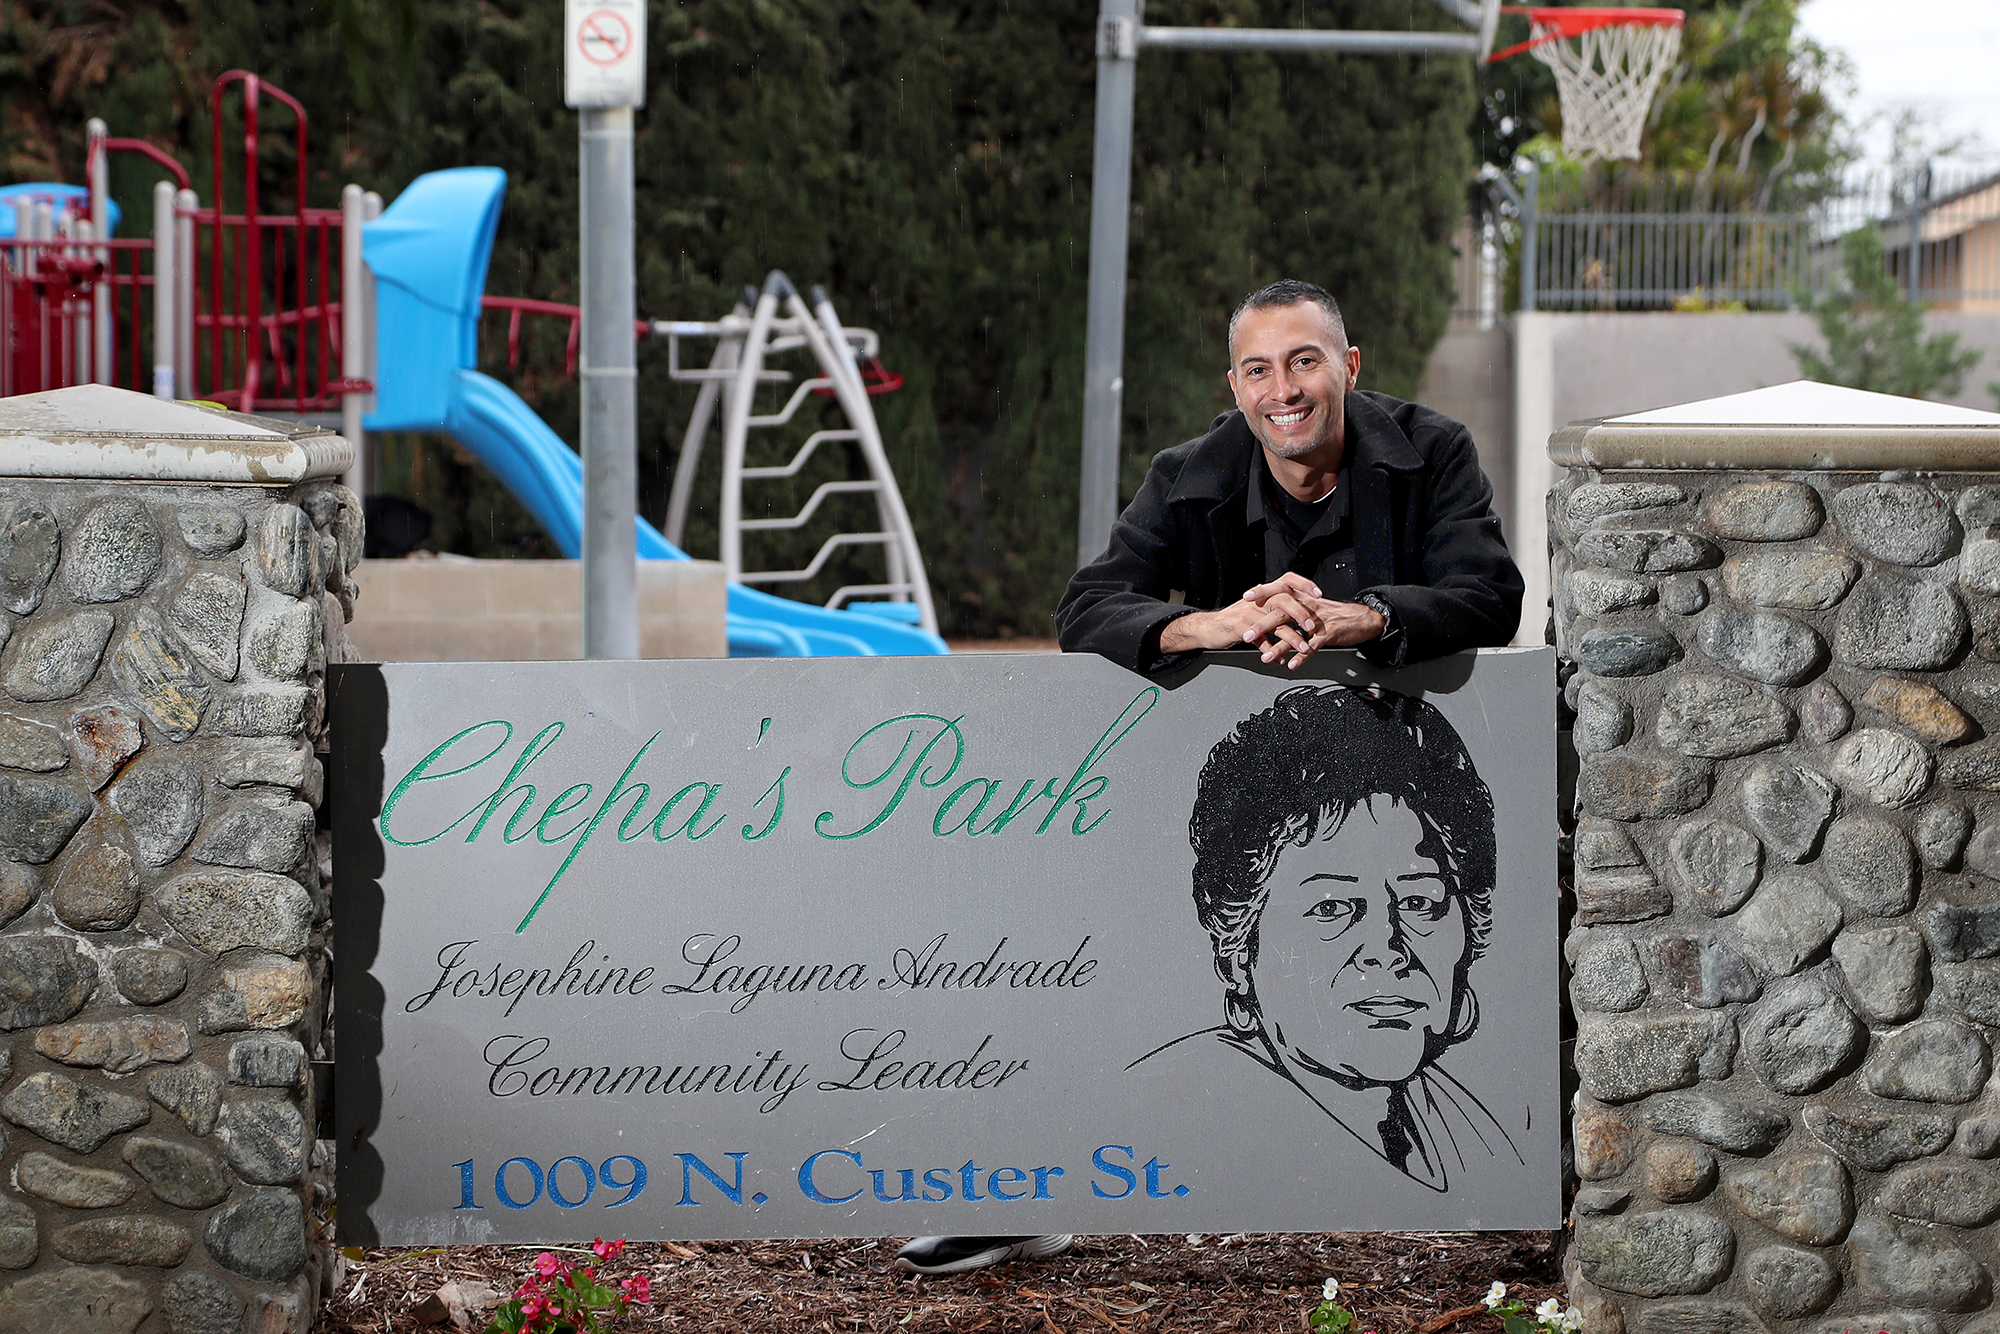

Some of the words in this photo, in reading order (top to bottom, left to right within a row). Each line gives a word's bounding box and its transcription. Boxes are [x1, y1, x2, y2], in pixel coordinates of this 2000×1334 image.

[380, 718, 791, 934] Chepa's
[815, 687, 1160, 840] Park
[405, 940, 654, 1017] Josephine
[662, 934, 868, 1014] Laguna
[878, 933, 1098, 990] Andrade
[484, 1035, 810, 1114] Community
[817, 1028, 1029, 1091] Leader
[452, 1155, 648, 1210] 1009
[674, 1152, 768, 1206] N.
[798, 1150, 1065, 1204] Custer
[1092, 1145, 1190, 1199] St.
